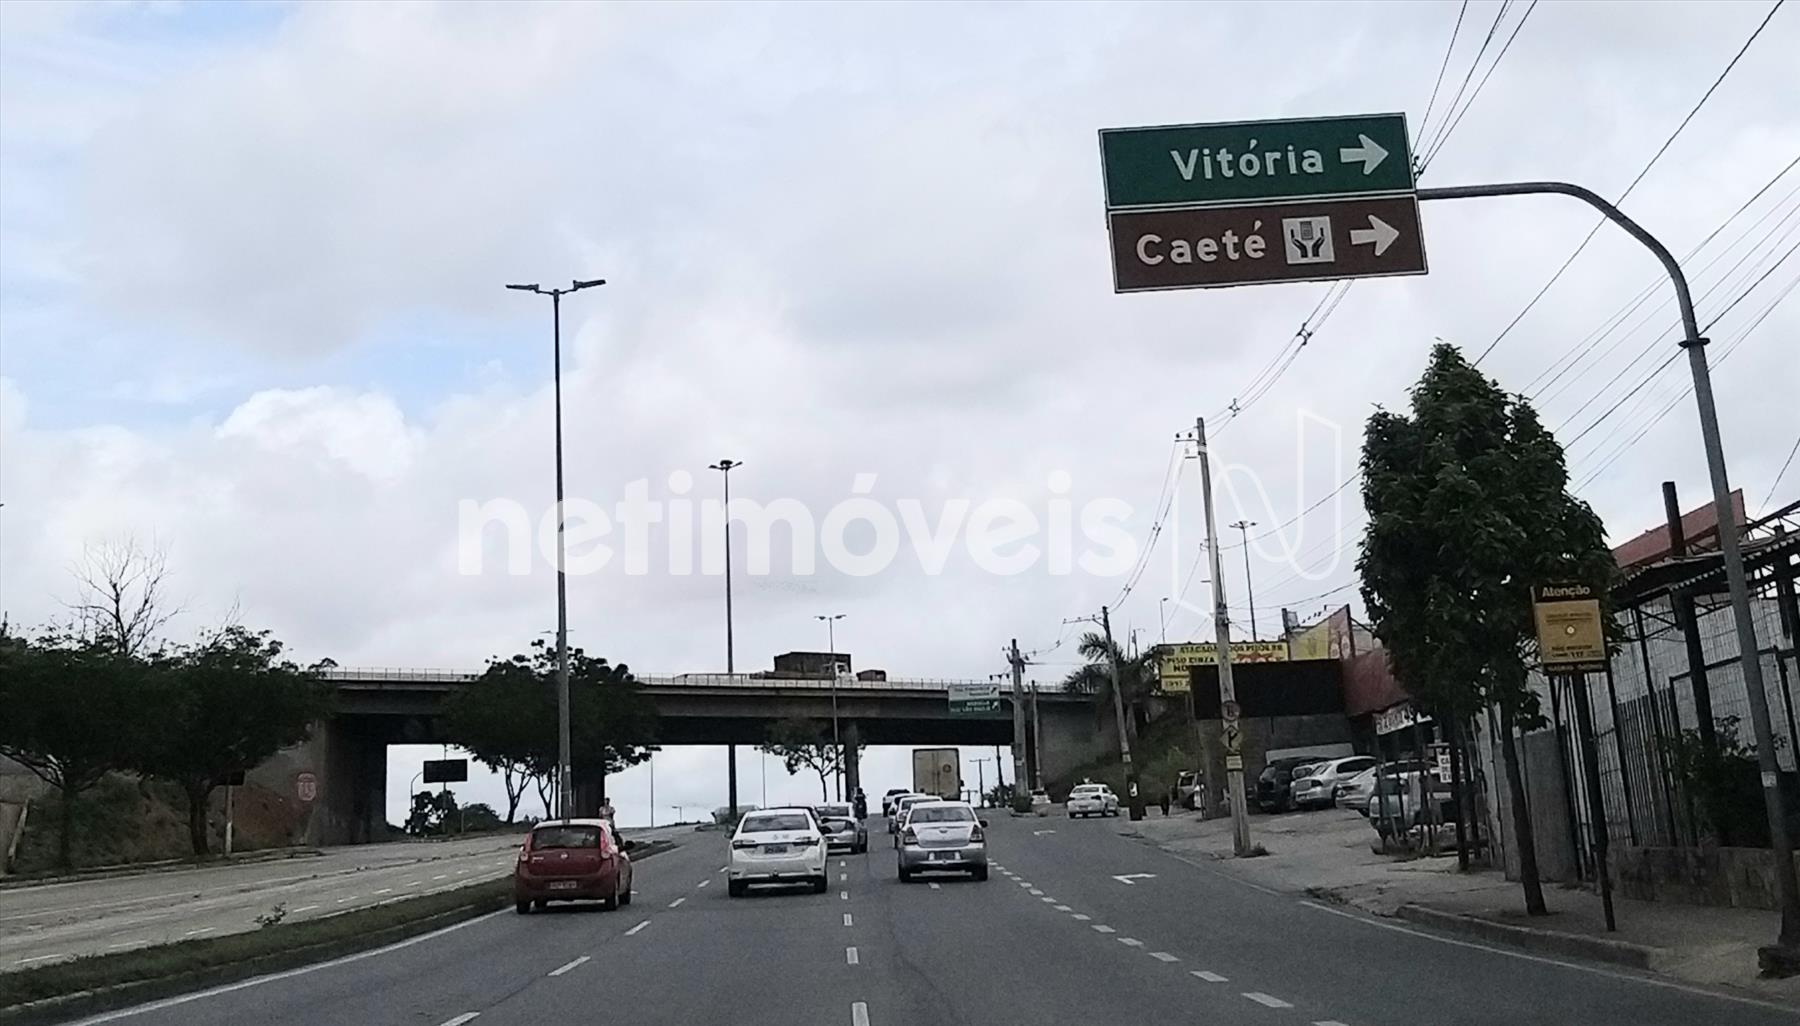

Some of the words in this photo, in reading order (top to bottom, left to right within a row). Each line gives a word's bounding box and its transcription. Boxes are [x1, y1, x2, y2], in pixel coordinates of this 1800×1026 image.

[1169, 138, 1325, 181] Vitória
[1135, 220, 1267, 265] Caeté
[1542, 585, 1591, 598] Atenção
